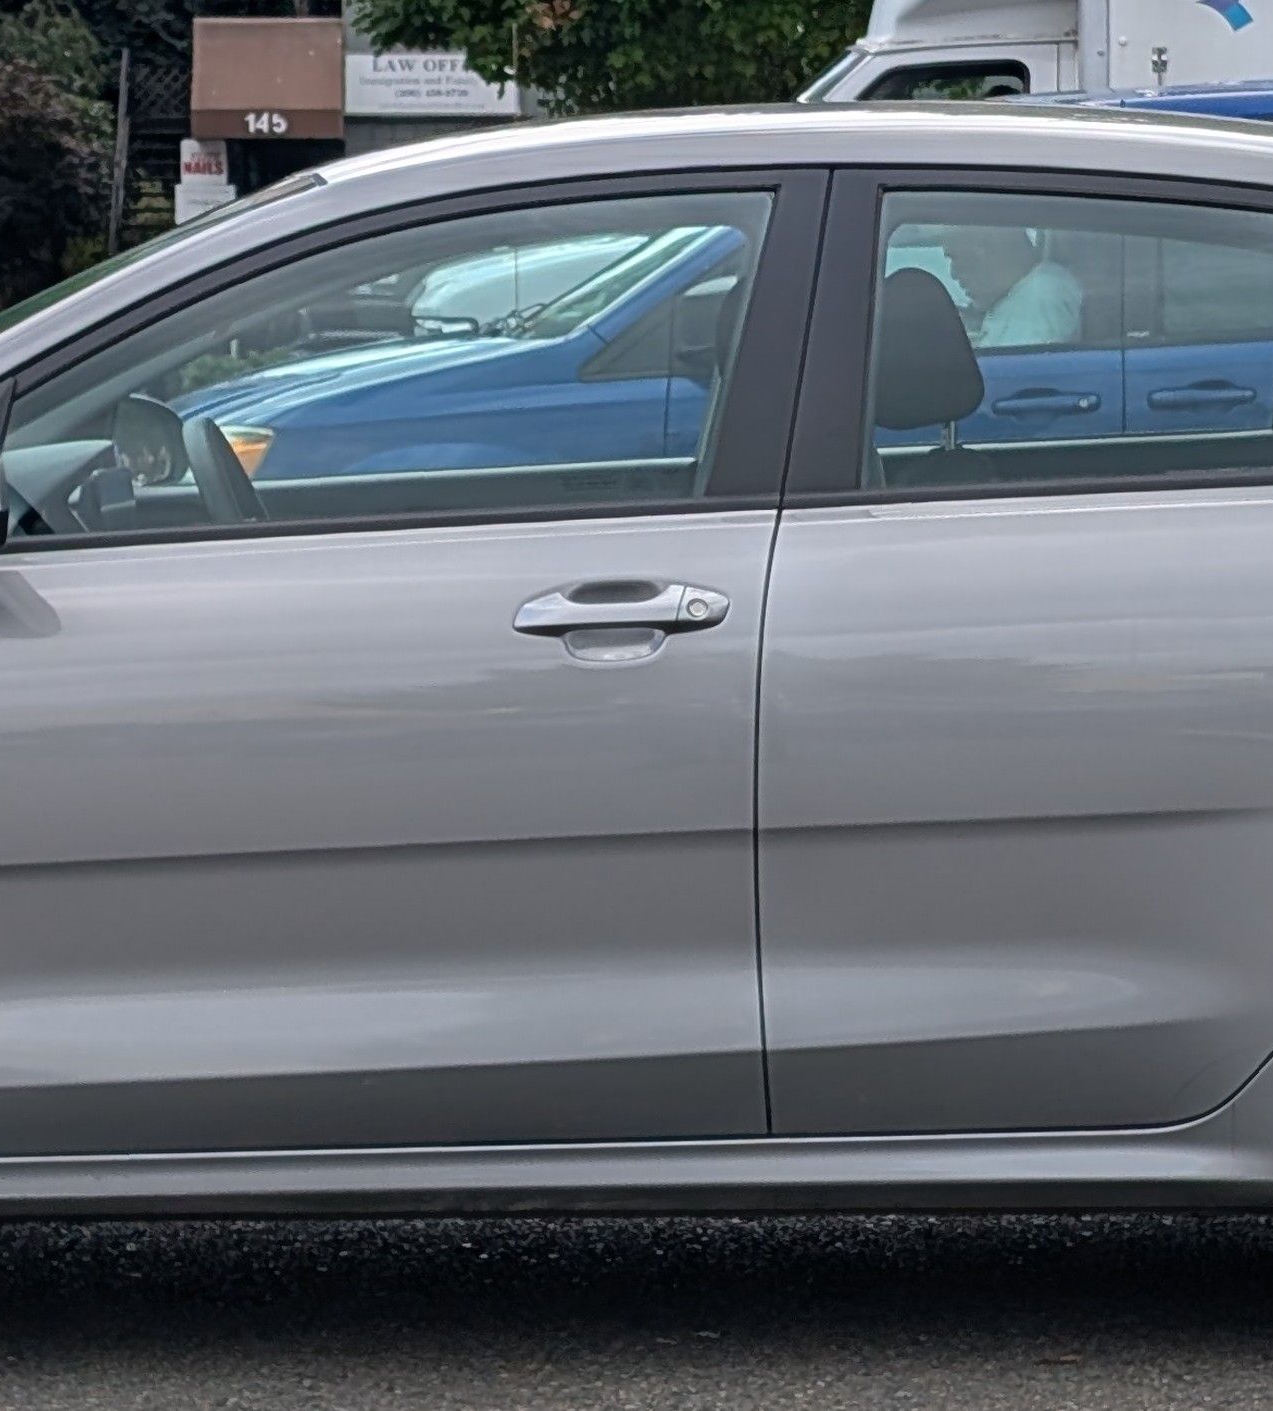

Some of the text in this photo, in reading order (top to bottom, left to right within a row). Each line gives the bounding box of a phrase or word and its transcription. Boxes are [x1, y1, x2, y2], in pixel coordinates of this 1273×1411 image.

[372, 58, 467, 73] LAW OFF
[244, 111, 288, 133] 145
[183, 160, 224, 176] NAILS
